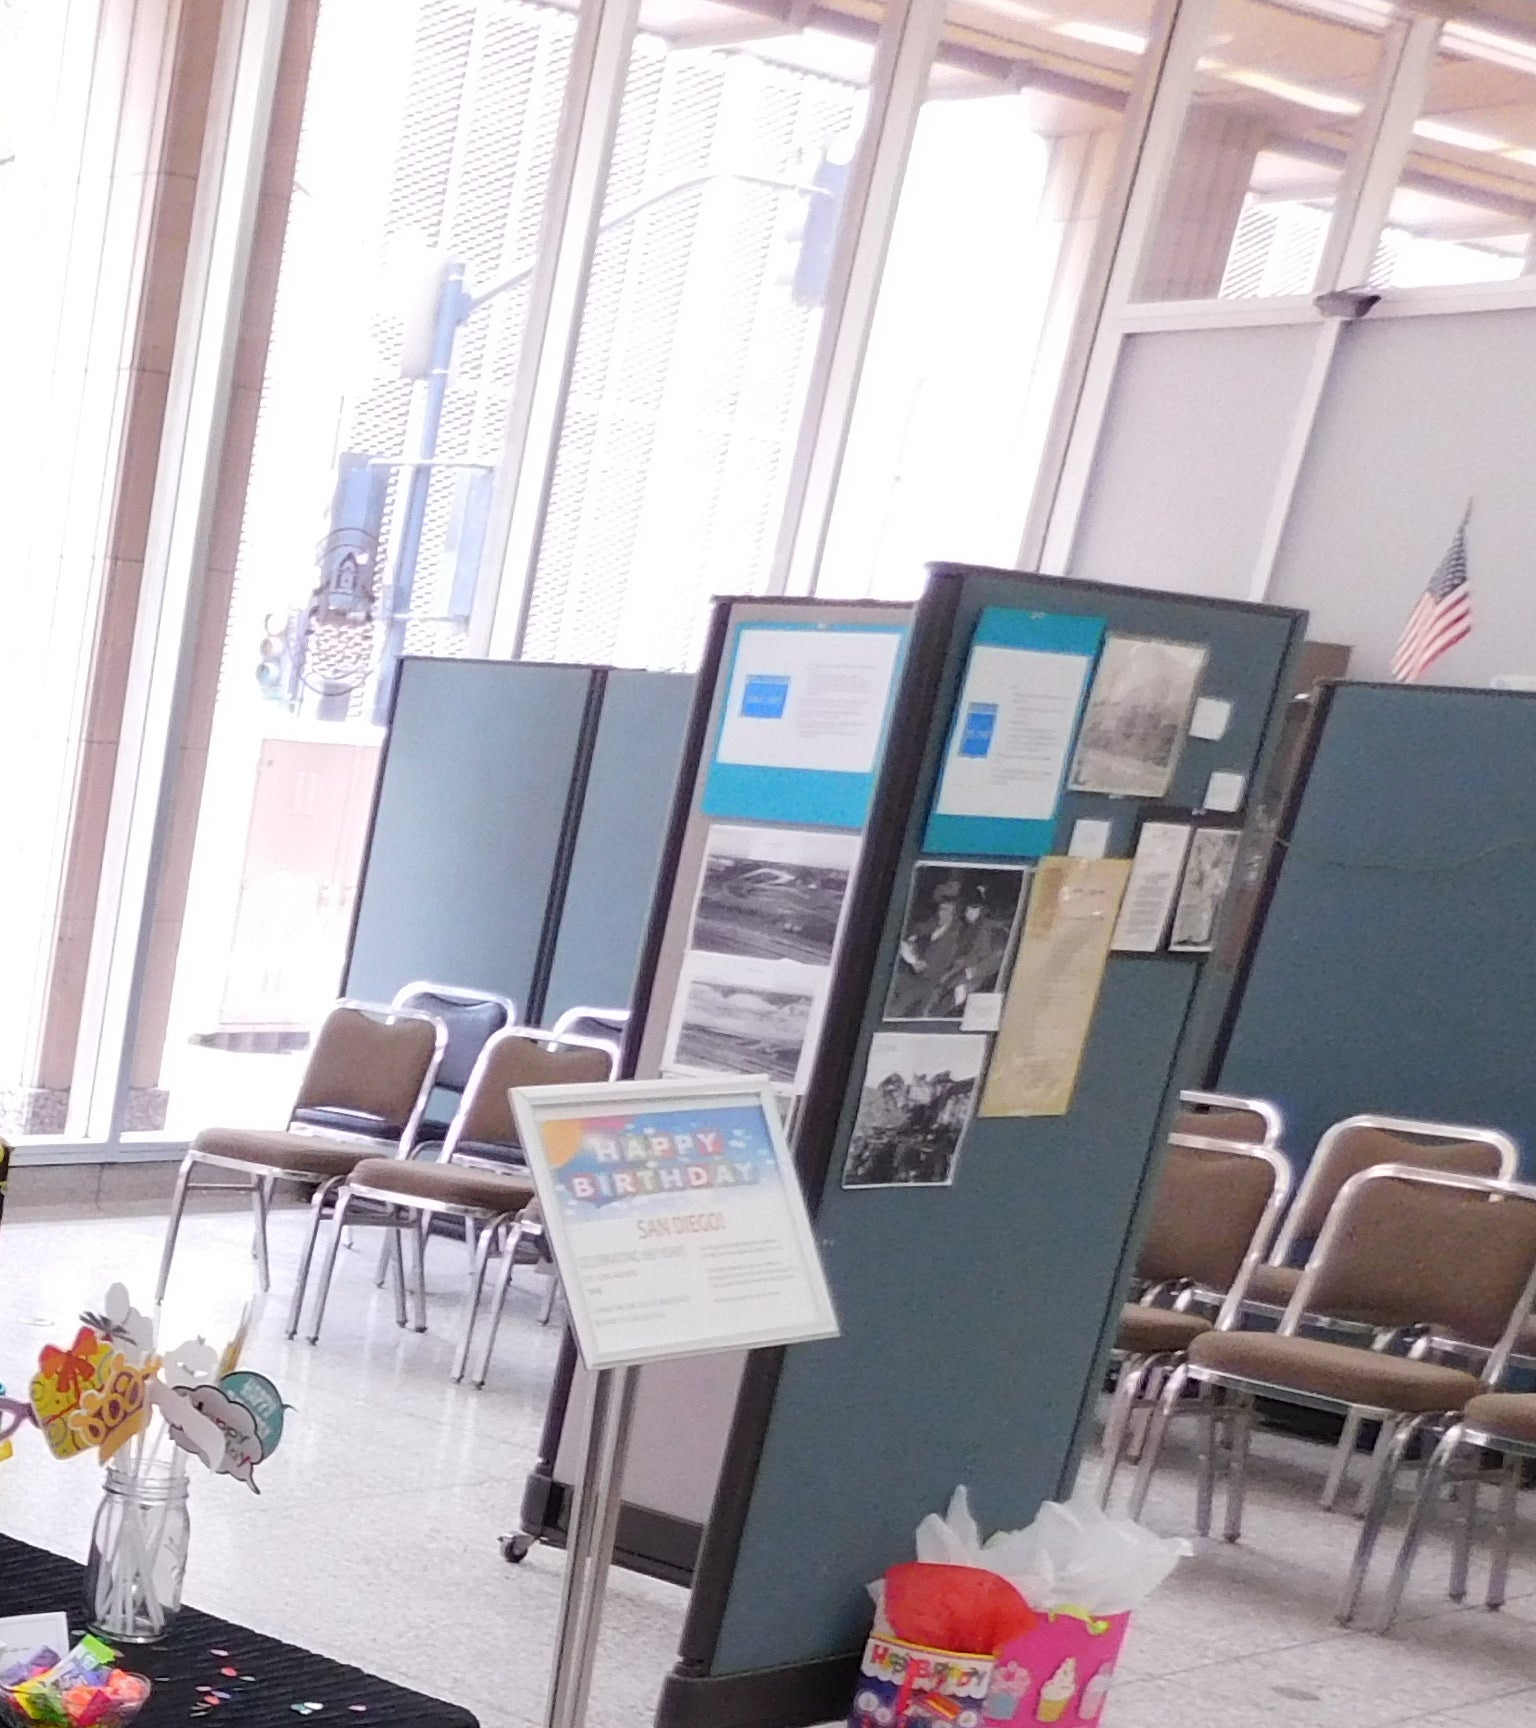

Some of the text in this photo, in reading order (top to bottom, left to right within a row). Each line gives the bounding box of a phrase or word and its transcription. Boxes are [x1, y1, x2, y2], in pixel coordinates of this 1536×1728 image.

[593, 1132, 720, 1164] HAPPY
[572, 1161, 754, 1198] BIRTHDAY
[636, 1216, 675, 1239] SAN
